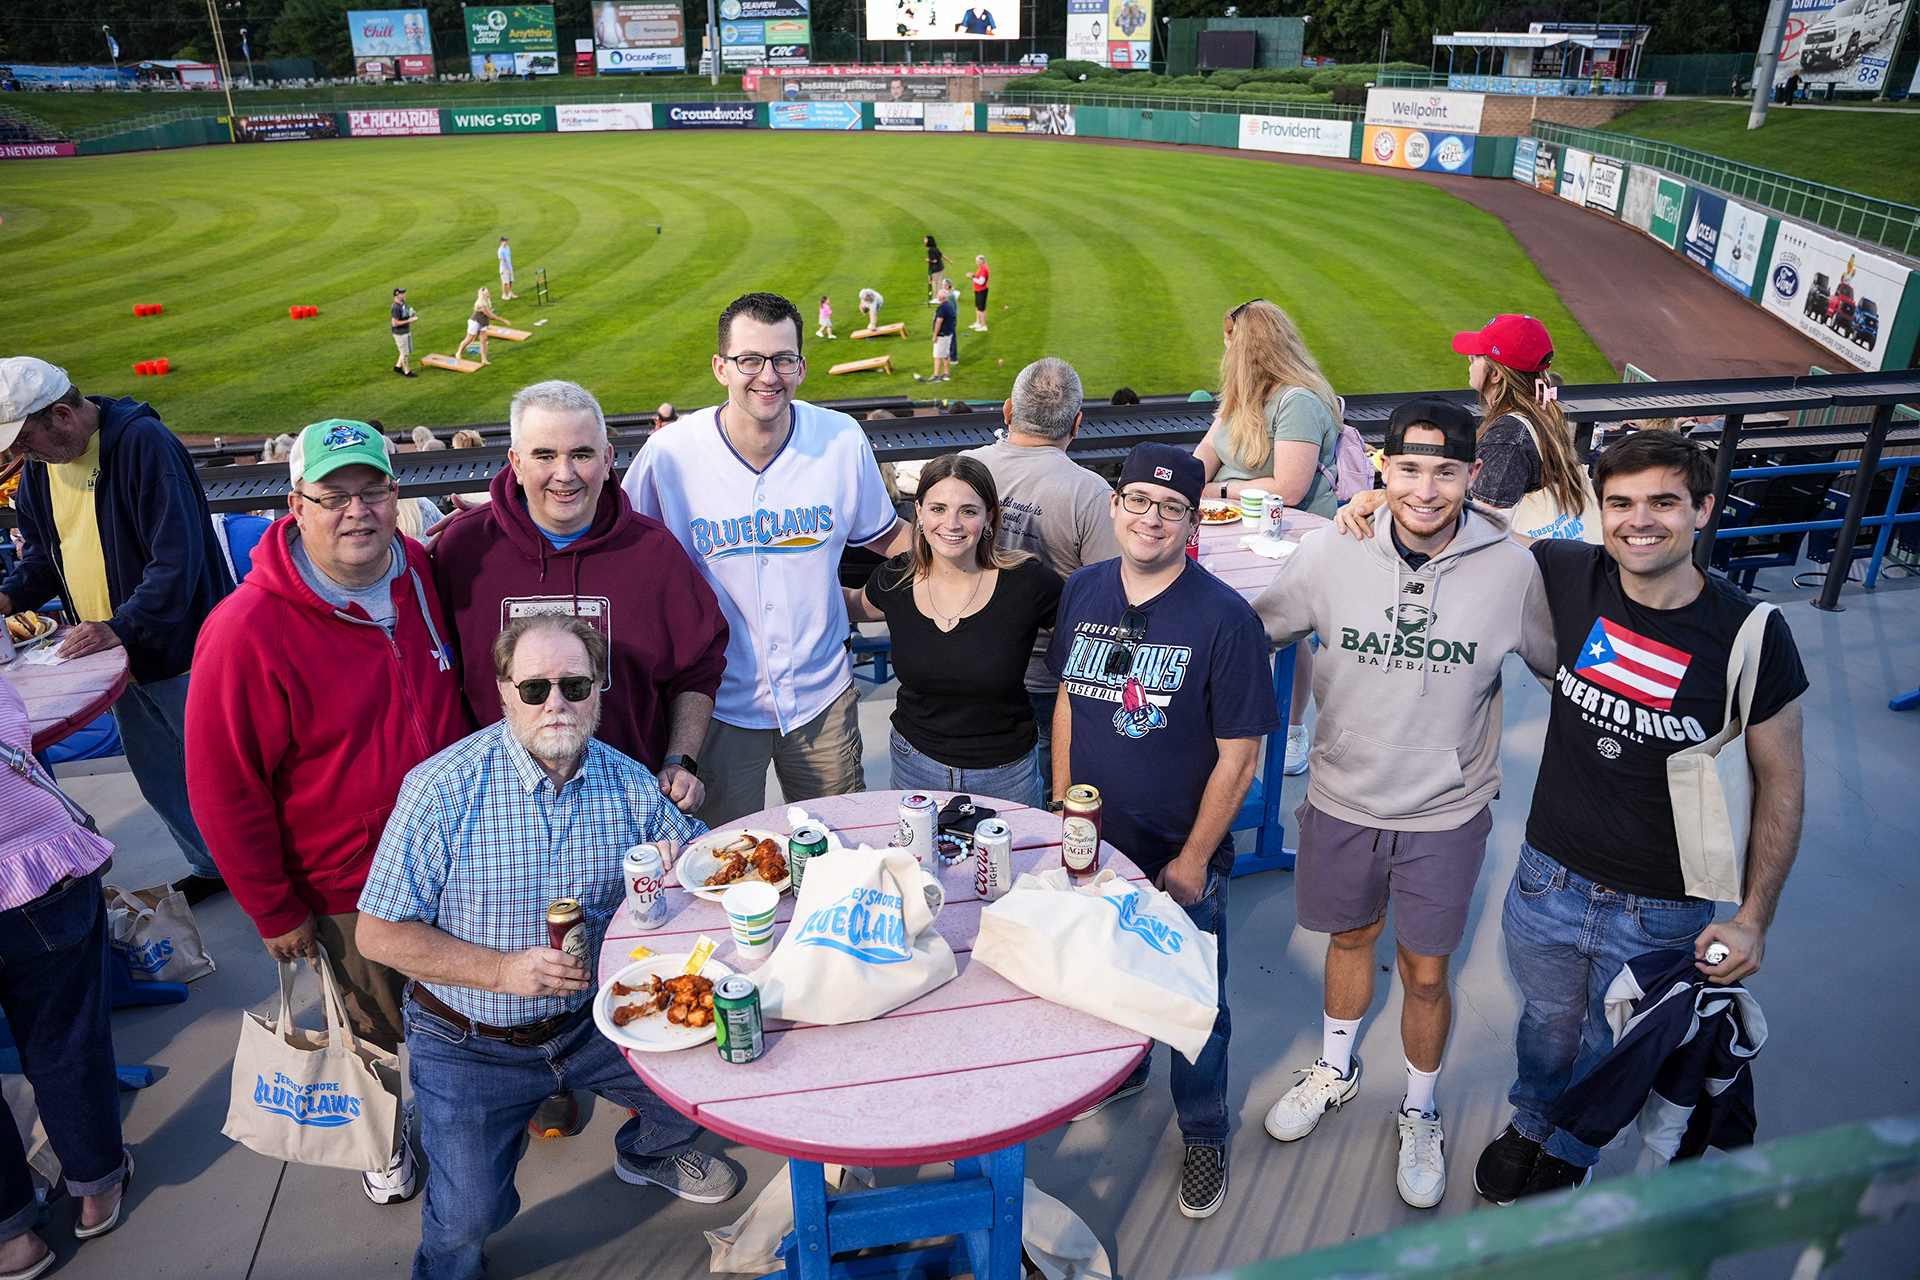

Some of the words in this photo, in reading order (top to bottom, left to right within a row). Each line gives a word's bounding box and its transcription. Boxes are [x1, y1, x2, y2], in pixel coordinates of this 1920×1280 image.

[741, 1, 777, 10] SEAVIEW
[742, 8, 800, 17] ORTHOPAEDICS
[363, 25, 394, 38] Chill
[478, 30, 500, 38] Jersey
[509, 30, 552, 39] Anything
[474, 37, 500, 45] Lottery
[1858, 67, 1879, 84] 88
[248, 113, 319, 122] INTERNATIONAL
[670, 106, 754, 121] Groundworks
[1392, 102, 1447, 119] Wellpoint
[369, 111, 430, 128] RICHARD
[1262, 121, 1321, 139] Provident
[6, 146, 58, 157] NETWORK
[1698, 222, 1717, 245] OCEAN
[1776, 267, 1796, 295] Ford
[1012, 503, 1033, 513] needs
[1034, 506, 1043, 516] is
[690, 505, 833, 556] BLUECLAWS
[1341, 627, 1477, 664] BABSON
[1358, 655, 1452, 675] BAEBALL
[1556, 665, 1630, 725] PUERTO
[1635, 707, 1706, 745] RICO
[1582, 712, 1644, 745] BASEBALL
[1064, 844, 1093, 855] LAGER
[974, 846, 989, 896] Coors
[989, 862, 998, 887] LIGHT
[632, 874, 665, 894] Coo
[640, 889, 665, 904] LIG
[254, 1074, 361, 1119] BLUECLAWS
[305, 1082, 339, 1095] SHORE
